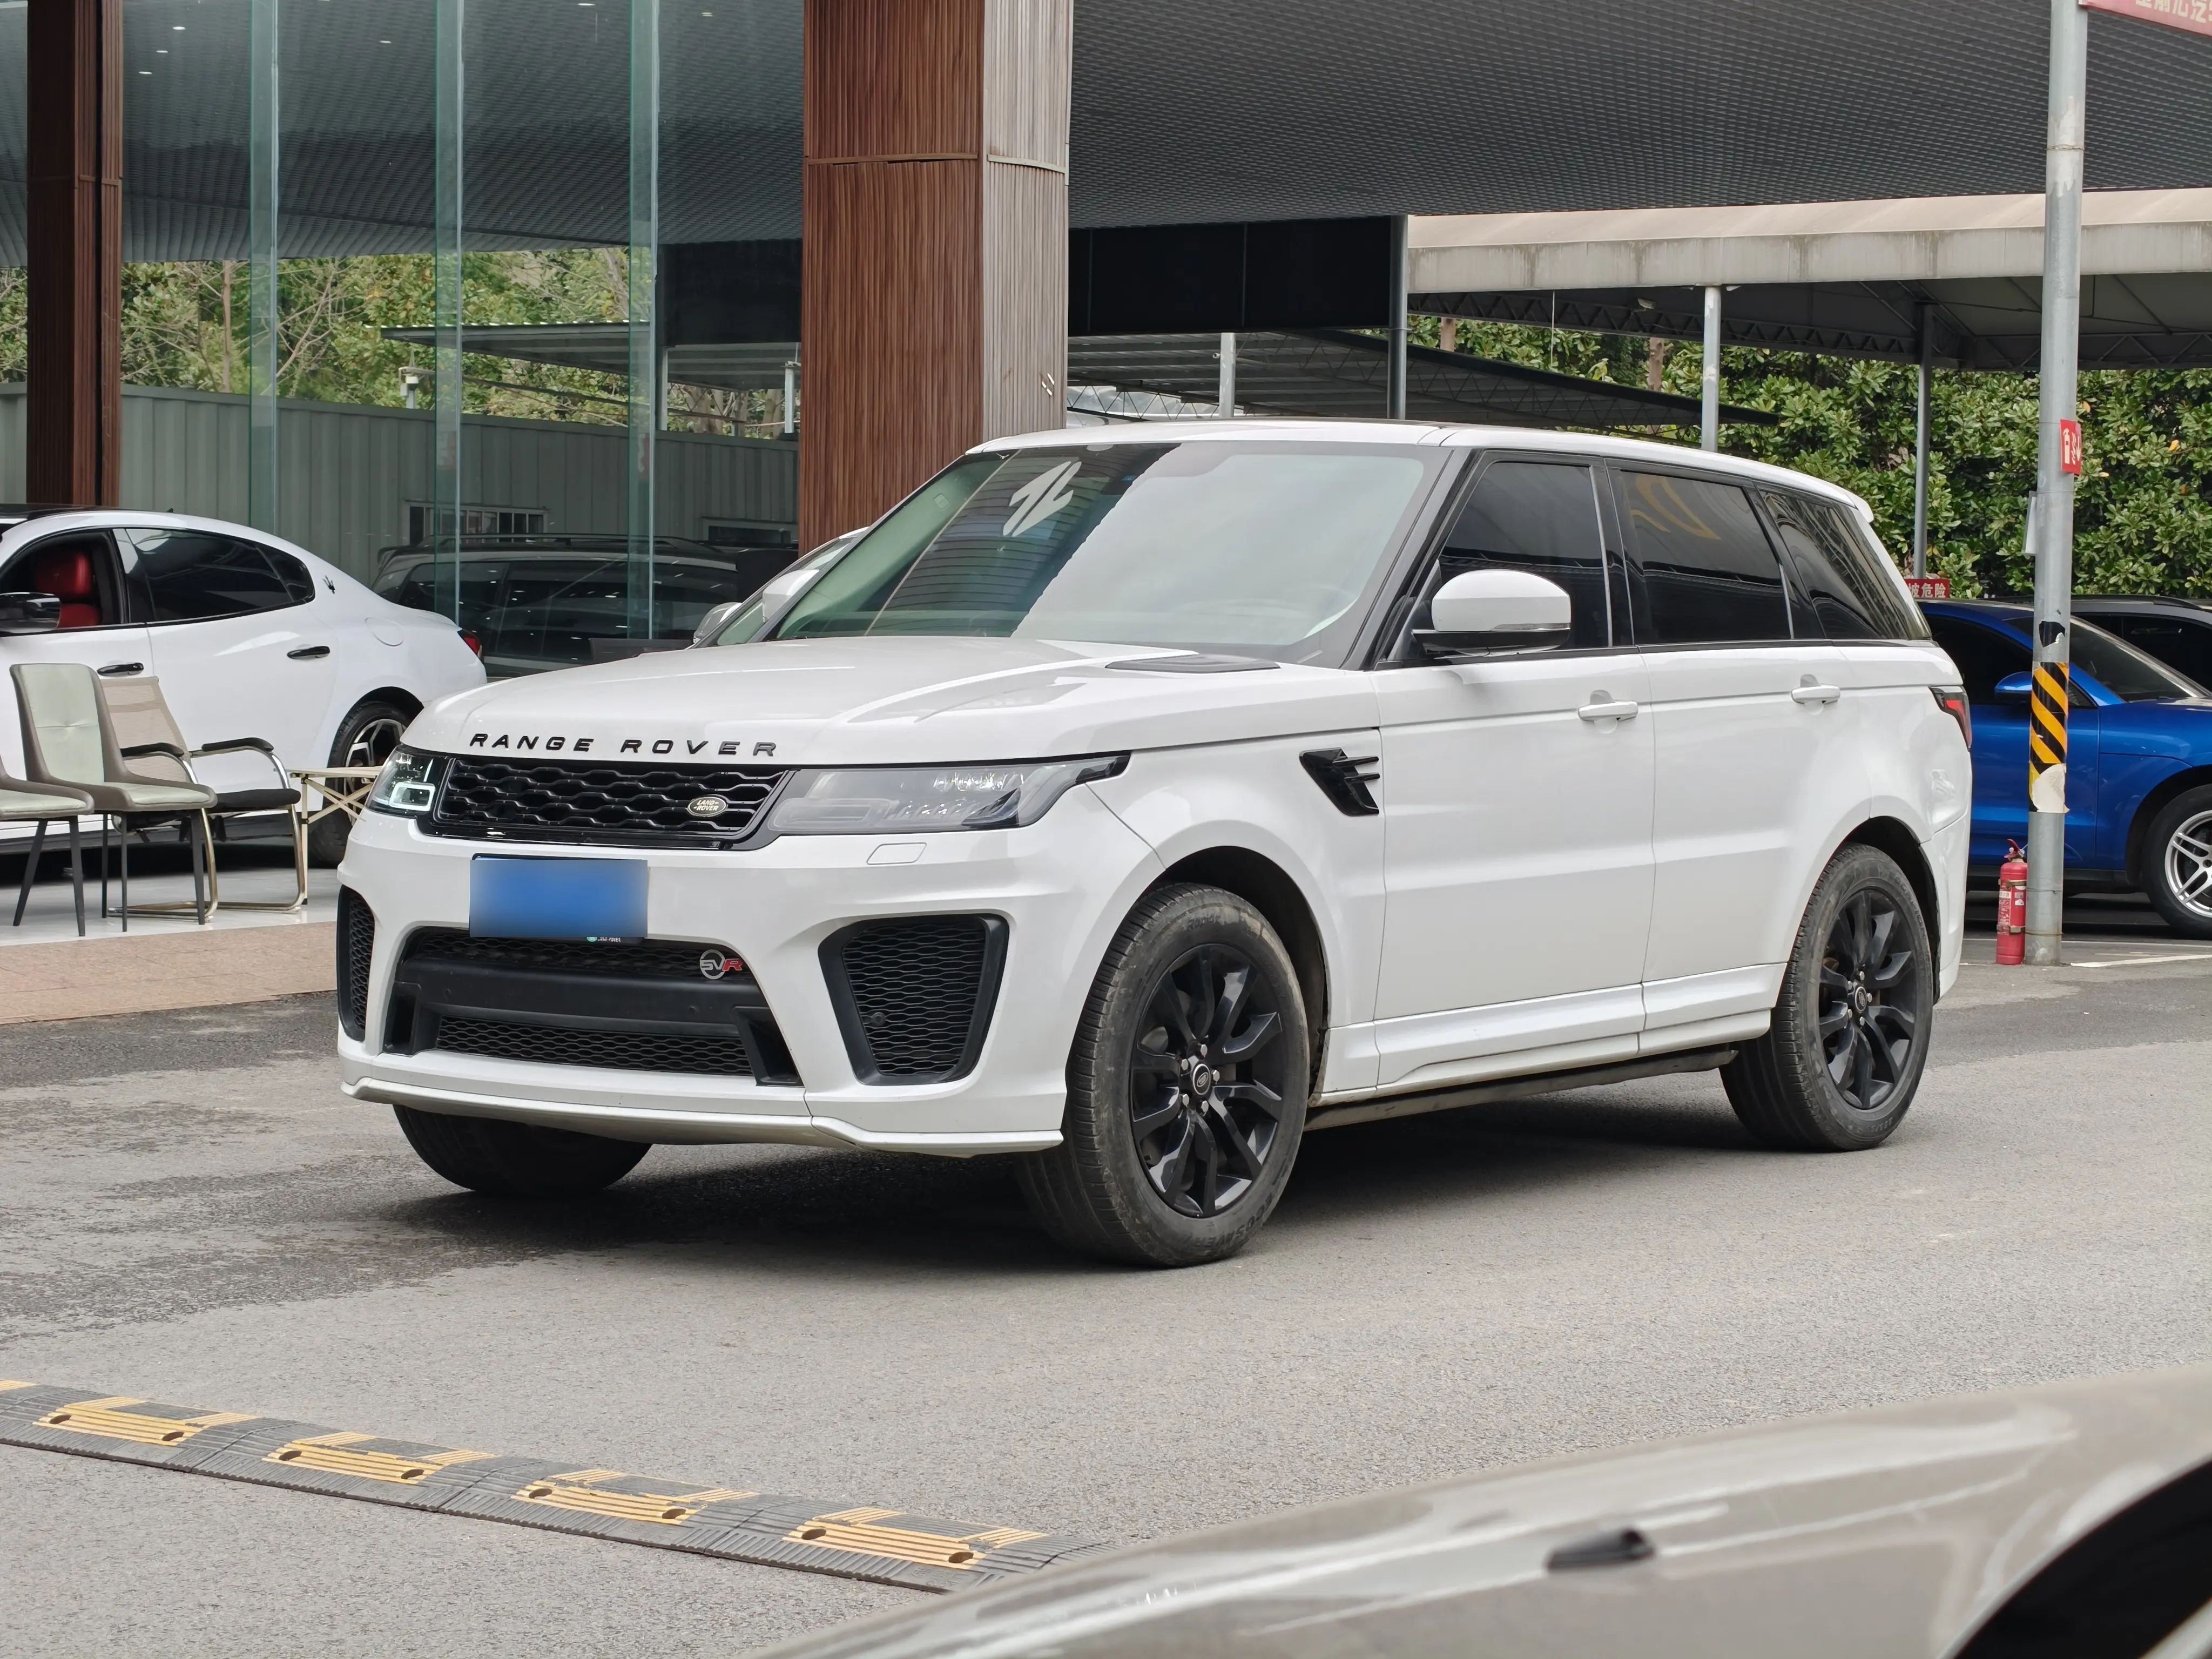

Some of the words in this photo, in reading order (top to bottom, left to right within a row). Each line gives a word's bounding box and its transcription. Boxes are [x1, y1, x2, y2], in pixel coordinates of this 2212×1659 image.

[470, 733, 594, 752] RANGE
[621, 739, 777, 756] ROVER
[700, 958, 743, 972] SVR
